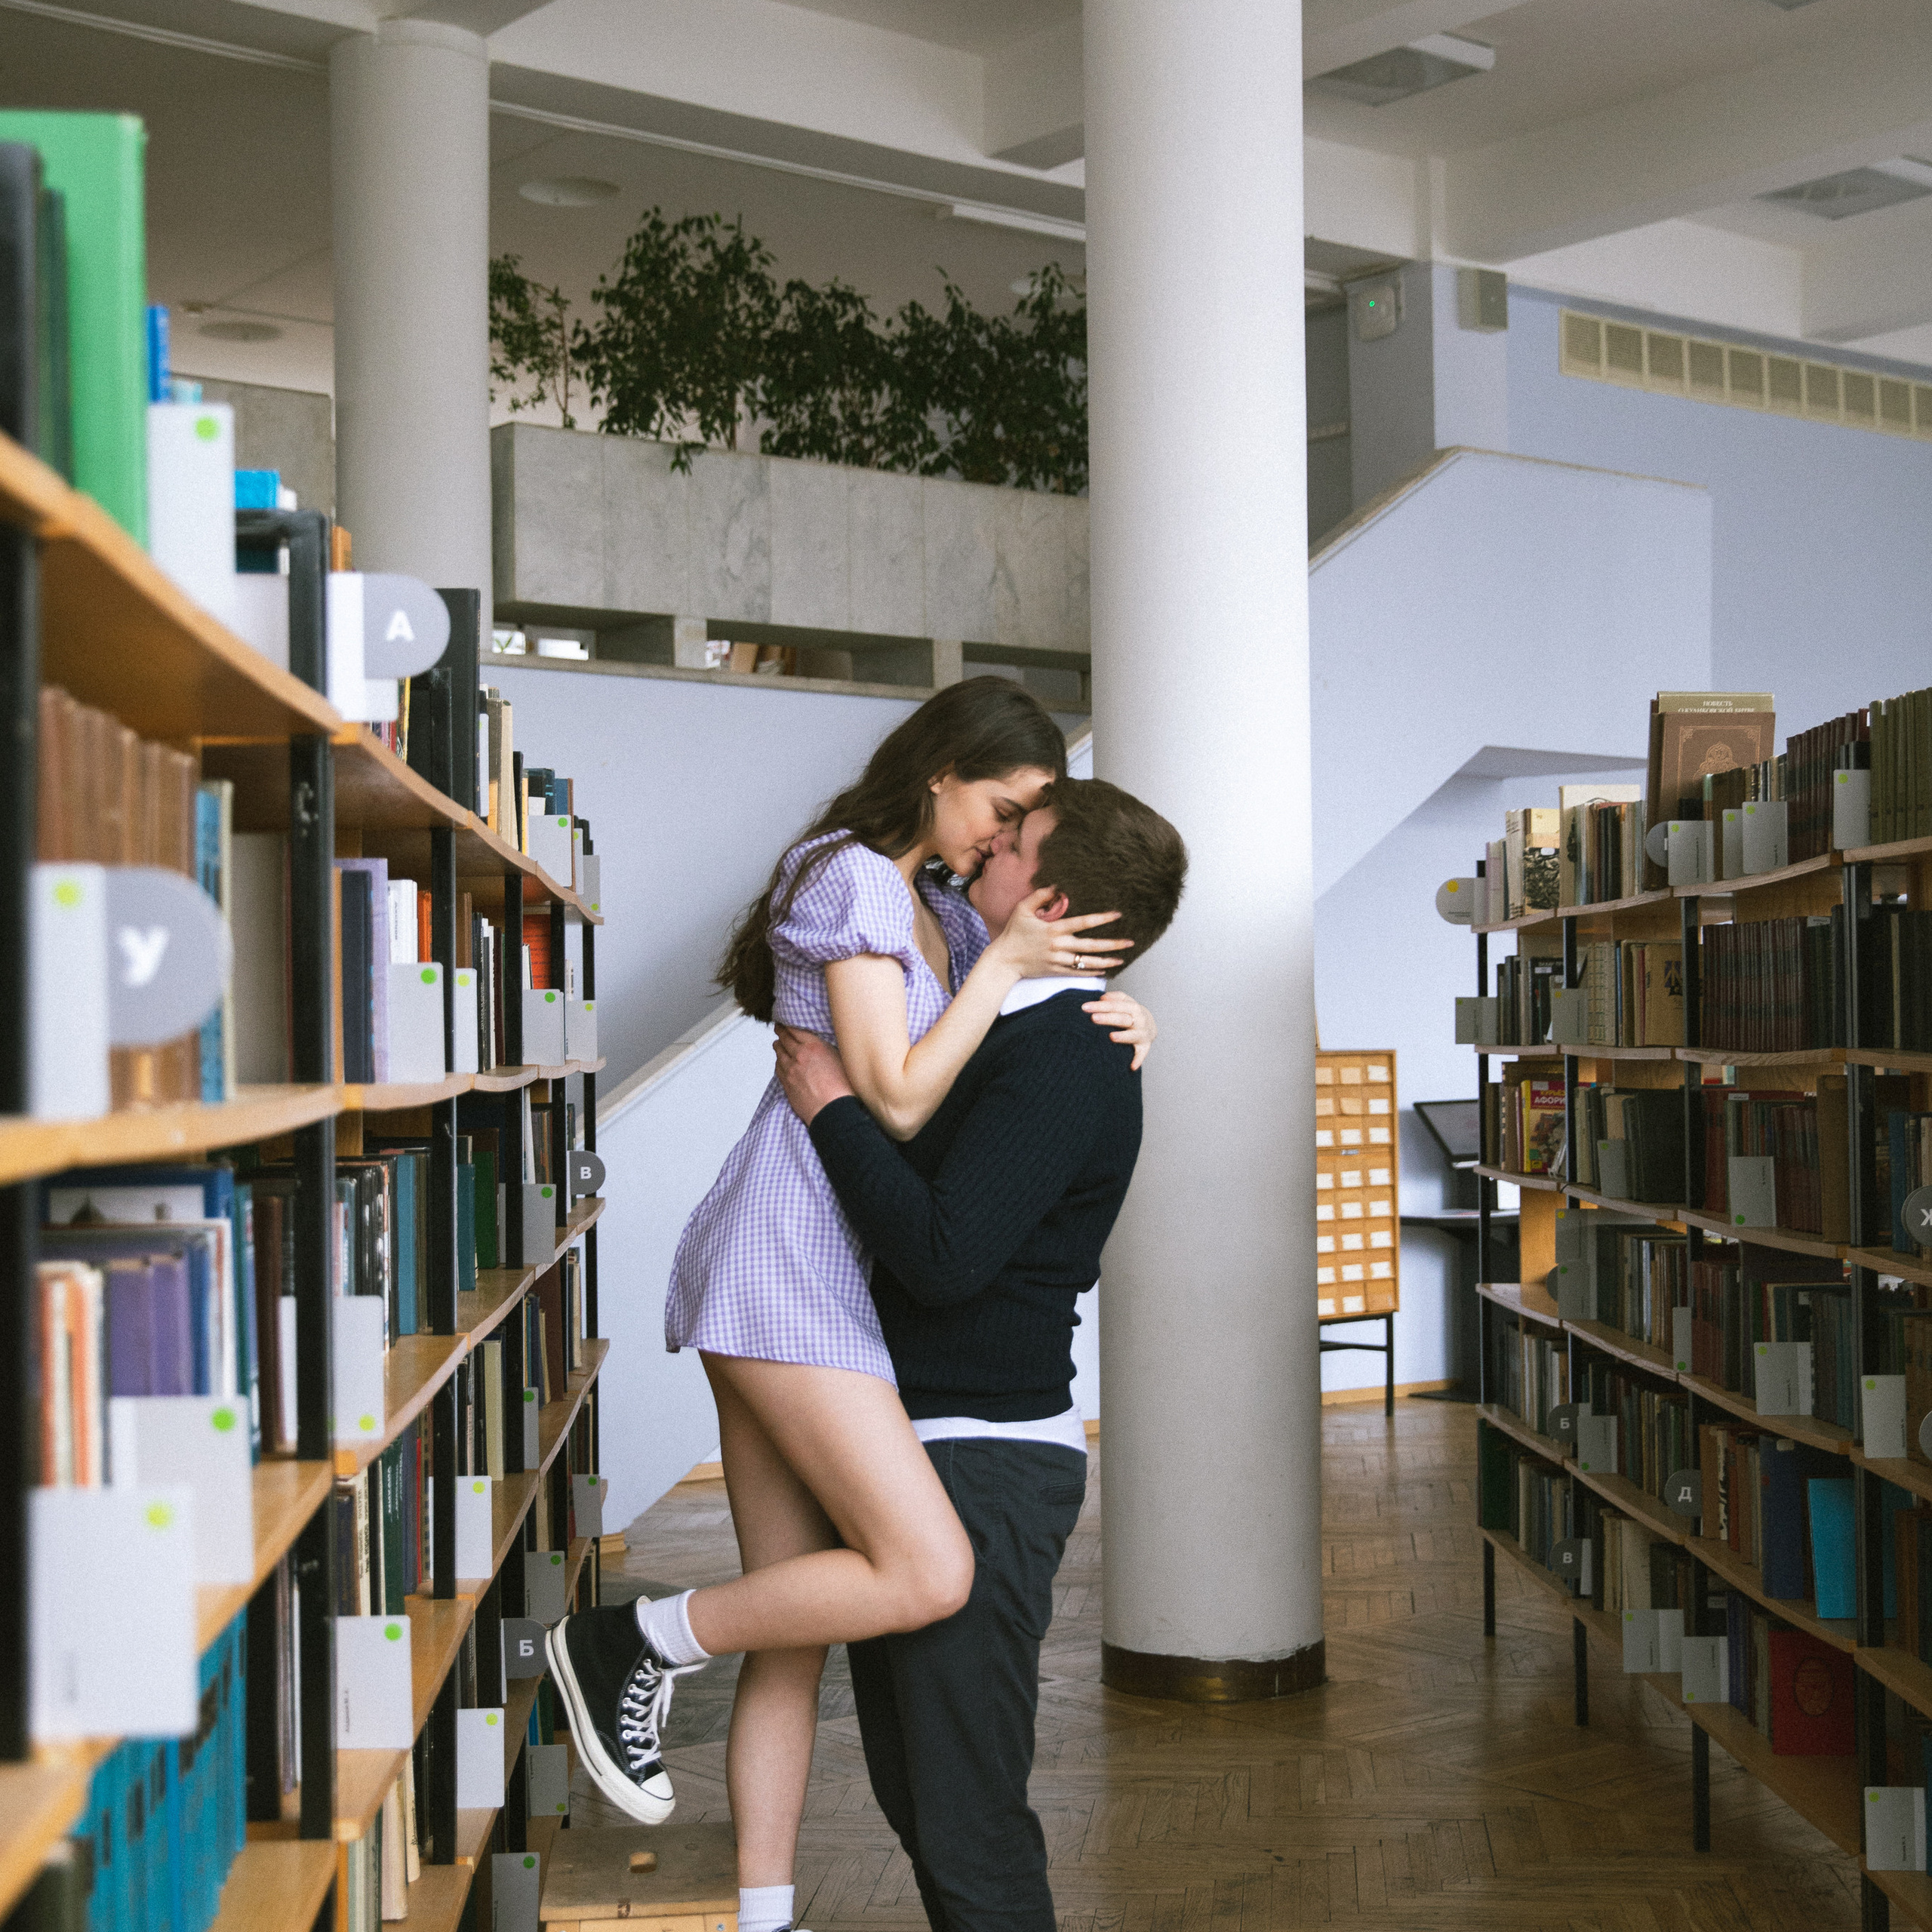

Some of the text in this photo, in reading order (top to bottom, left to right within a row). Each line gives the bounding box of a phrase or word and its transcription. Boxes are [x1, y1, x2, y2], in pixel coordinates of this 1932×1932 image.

[386, 609, 414, 641] А
[121, 928, 168, 985] У
[580, 1166, 592, 1180] В
[1560, 1417, 1570, 1429] Б
[1678, 1486, 1692, 1503] Д
[1562, 1552, 1573, 1564] В
[519, 1639, 534, 1657] Б
